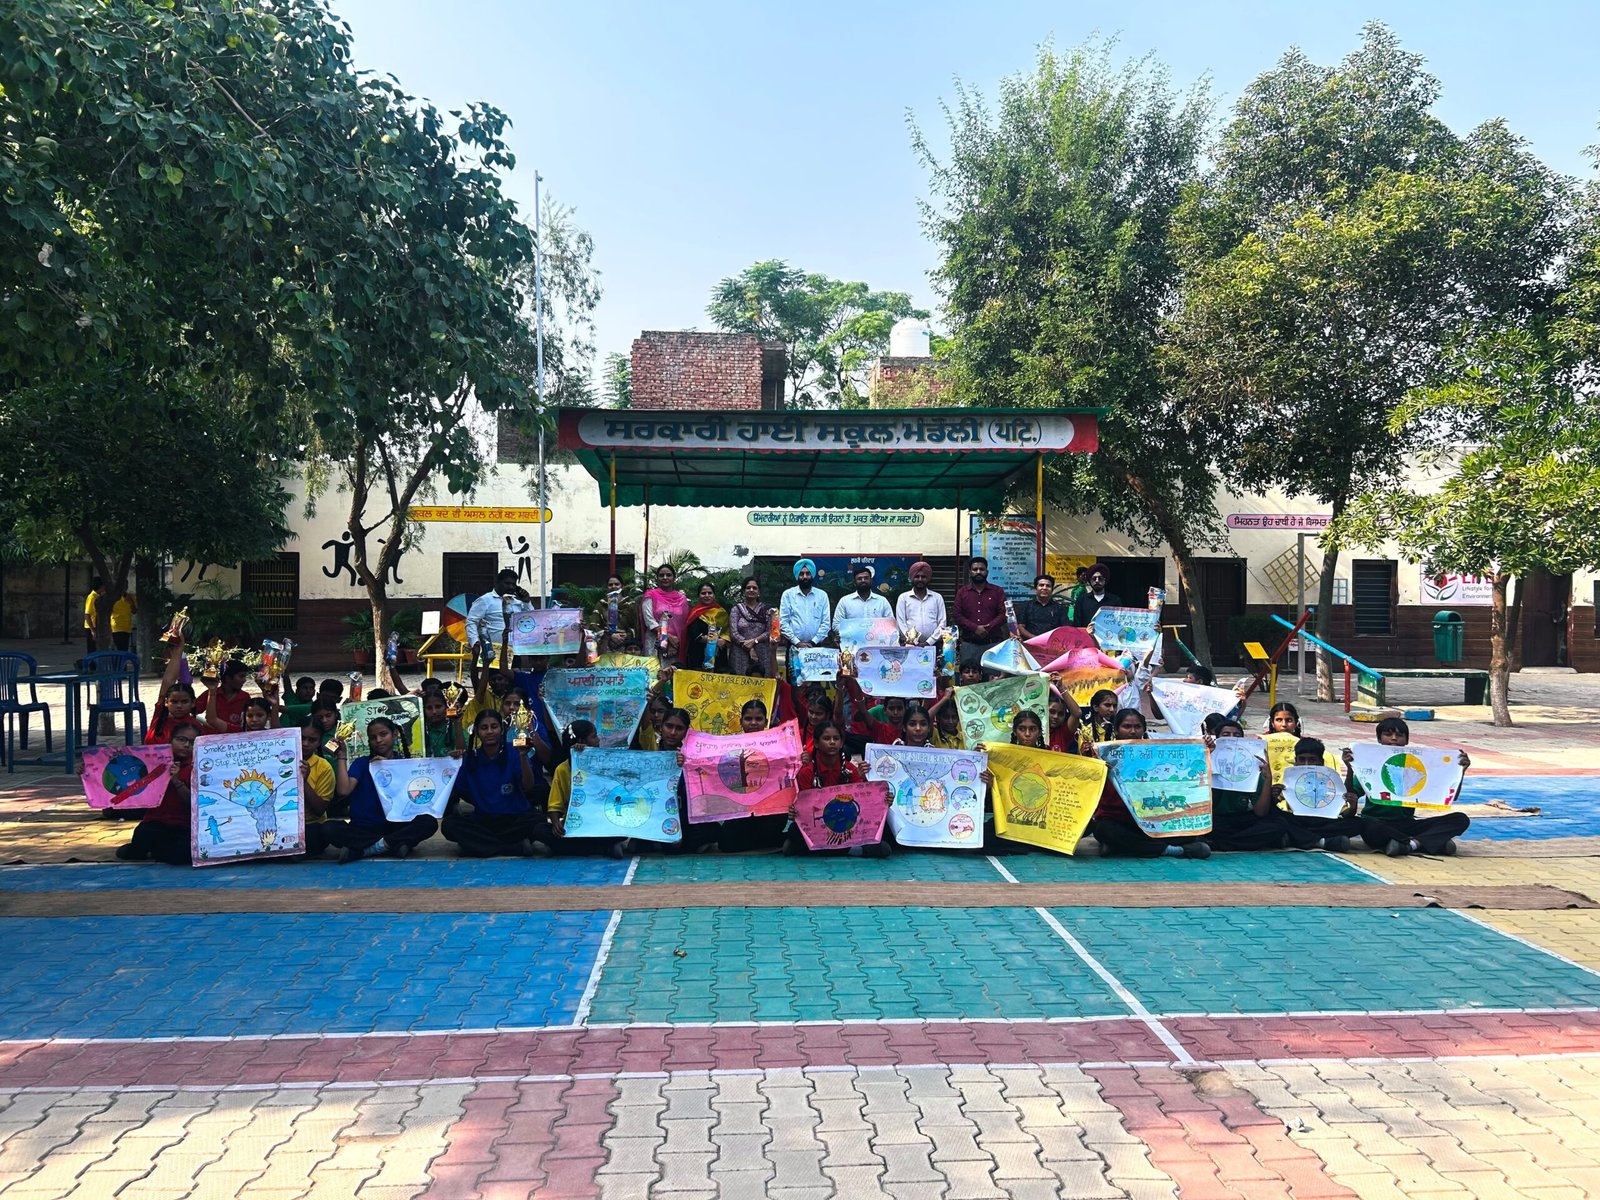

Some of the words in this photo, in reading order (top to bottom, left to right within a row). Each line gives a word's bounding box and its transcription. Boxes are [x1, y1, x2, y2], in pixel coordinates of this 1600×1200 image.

[604, 415, 732, 442] ਸਰਕਾਰੀ
[737, 416, 807, 443] ਹਾਈ
[700, 673, 717, 683] STOP
[367, 705, 387, 716] STOP
